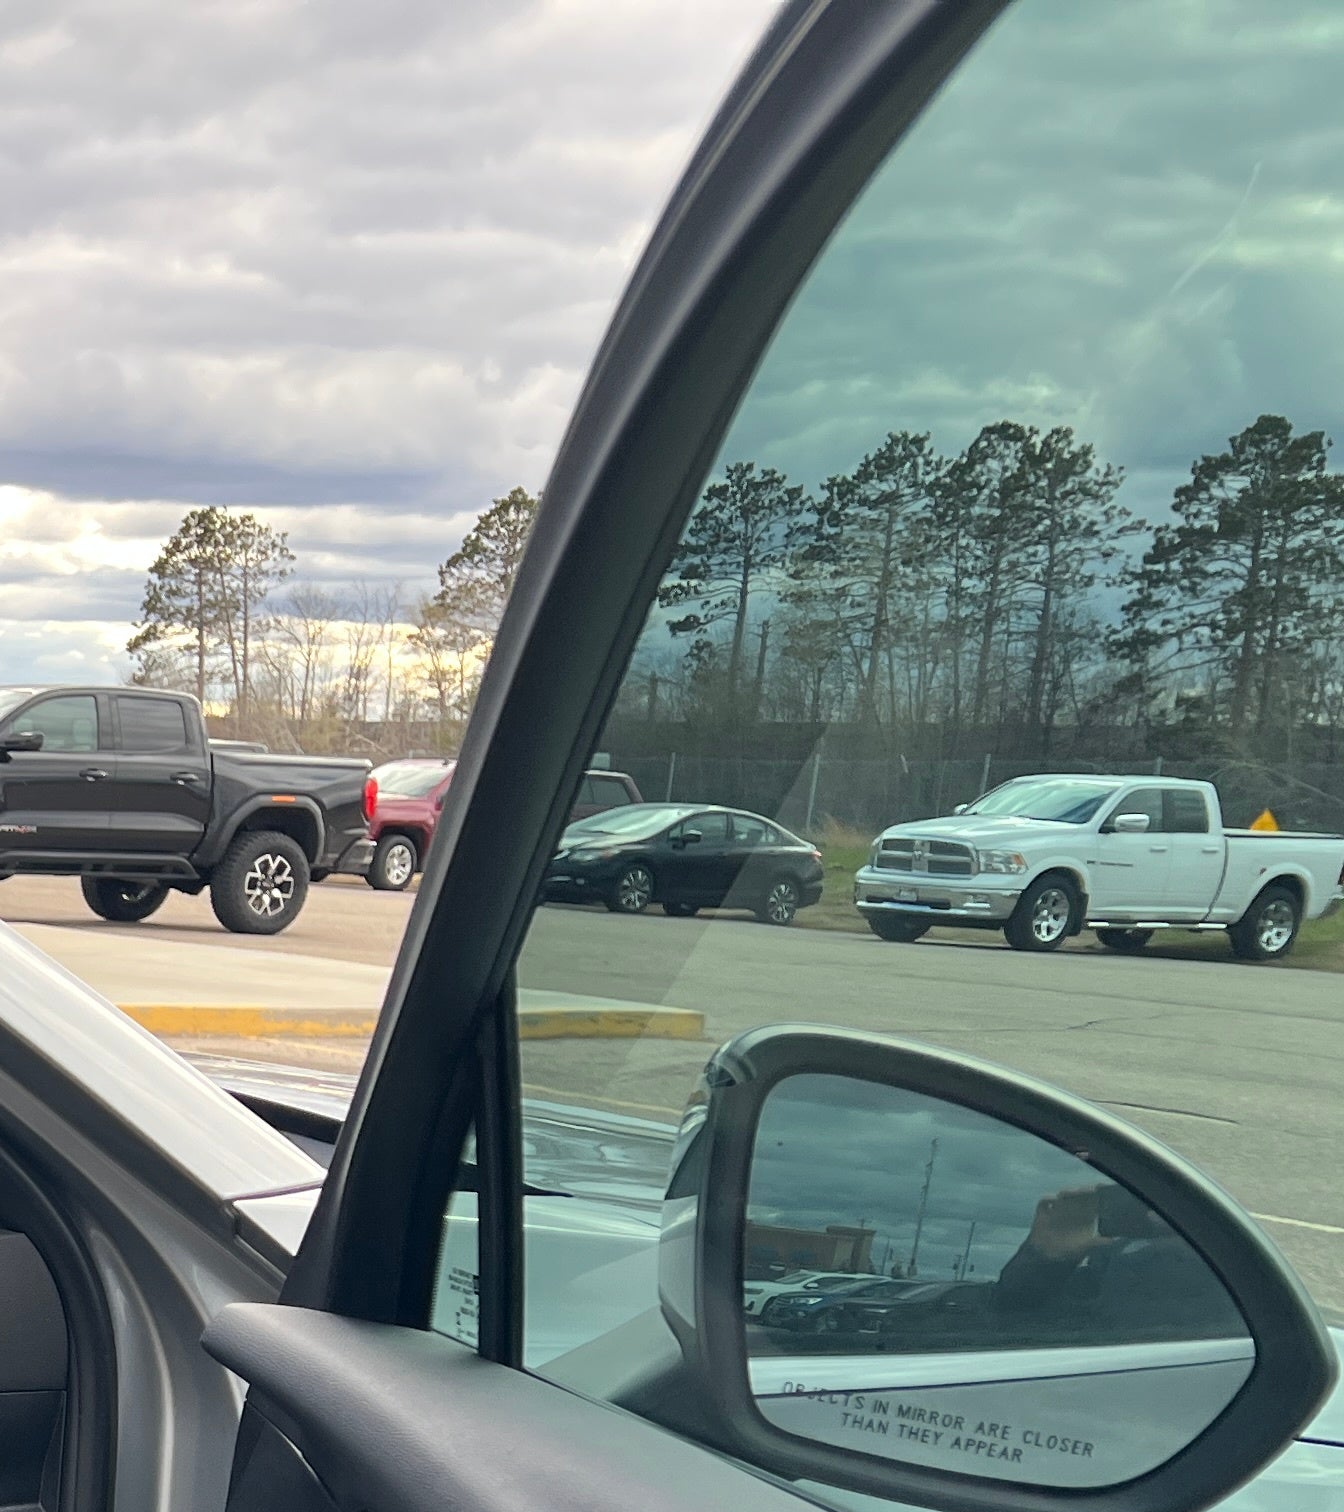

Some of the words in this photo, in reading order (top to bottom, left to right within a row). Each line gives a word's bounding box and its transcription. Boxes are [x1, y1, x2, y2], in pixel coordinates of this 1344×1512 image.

[783, 1381, 866, 1411] OBJECTS
[873, 1400, 890, 1416] IN
[897, 1404, 966, 1431] MIRROR
[975, 1420, 1011, 1441] ARE
[1022, 1429, 1095, 1459] CLOSER
[840, 1412, 890, 1435] THAN
[899, 1423, 945, 1447] THEY
[950, 1436, 1024, 1463] APPEAR
